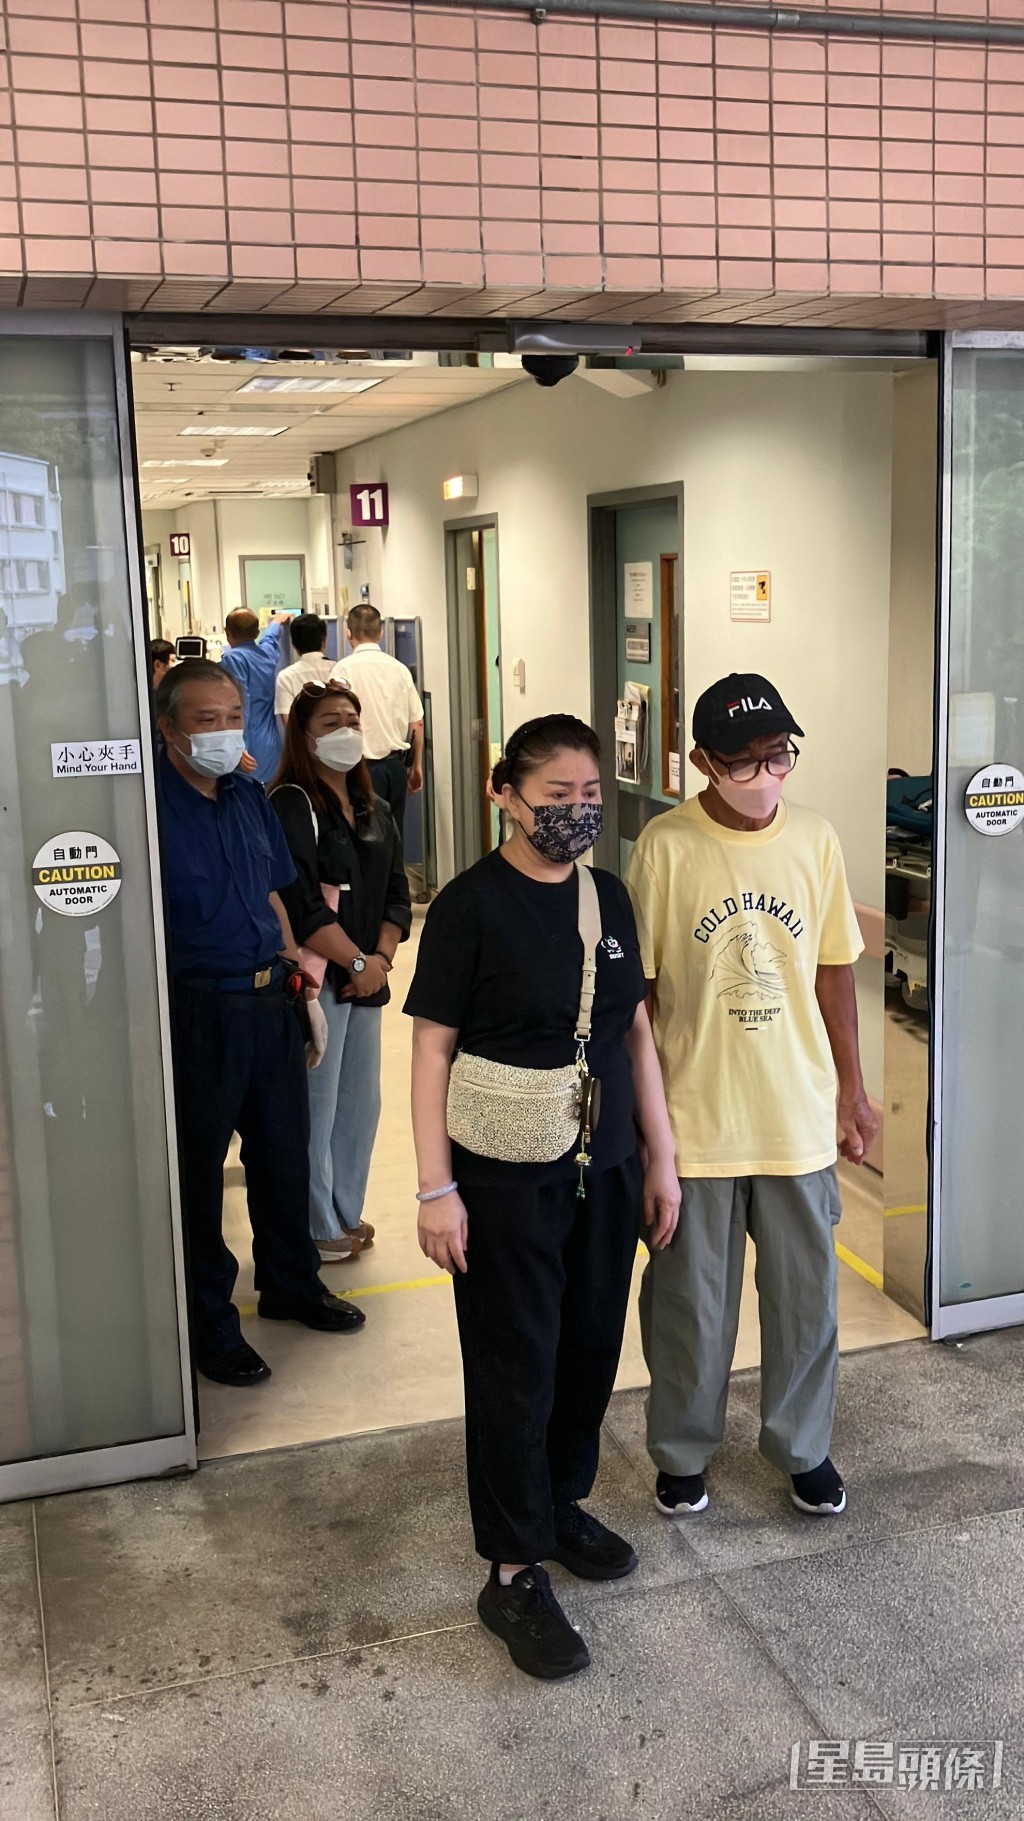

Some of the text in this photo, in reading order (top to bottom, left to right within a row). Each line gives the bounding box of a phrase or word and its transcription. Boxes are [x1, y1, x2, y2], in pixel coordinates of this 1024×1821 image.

[356, 489, 384, 521] 11
[171, 536, 189, 554] 10
[726, 697, 773, 718] FILA
[58, 744, 135, 763] 小心夾手
[57, 761, 137, 774] Mind Your Hand
[981, 776, 1014, 788] 自動門
[969, 793, 1024, 807] CAUTION
[976, 809, 1018, 819] AUTOMATIC
[53, 845, 98, 861] 自動門
[38, 866, 115, 883] CAUTION
[49, 885, 107, 896] AUTOMATIC
[65, 896, 93, 905] DOOR
[694, 893, 804, 944] COLD HAWAII
[728, 1007, 781, 1016] INTO THE DEEP
[738, 1015, 758, 1023] BLUE
